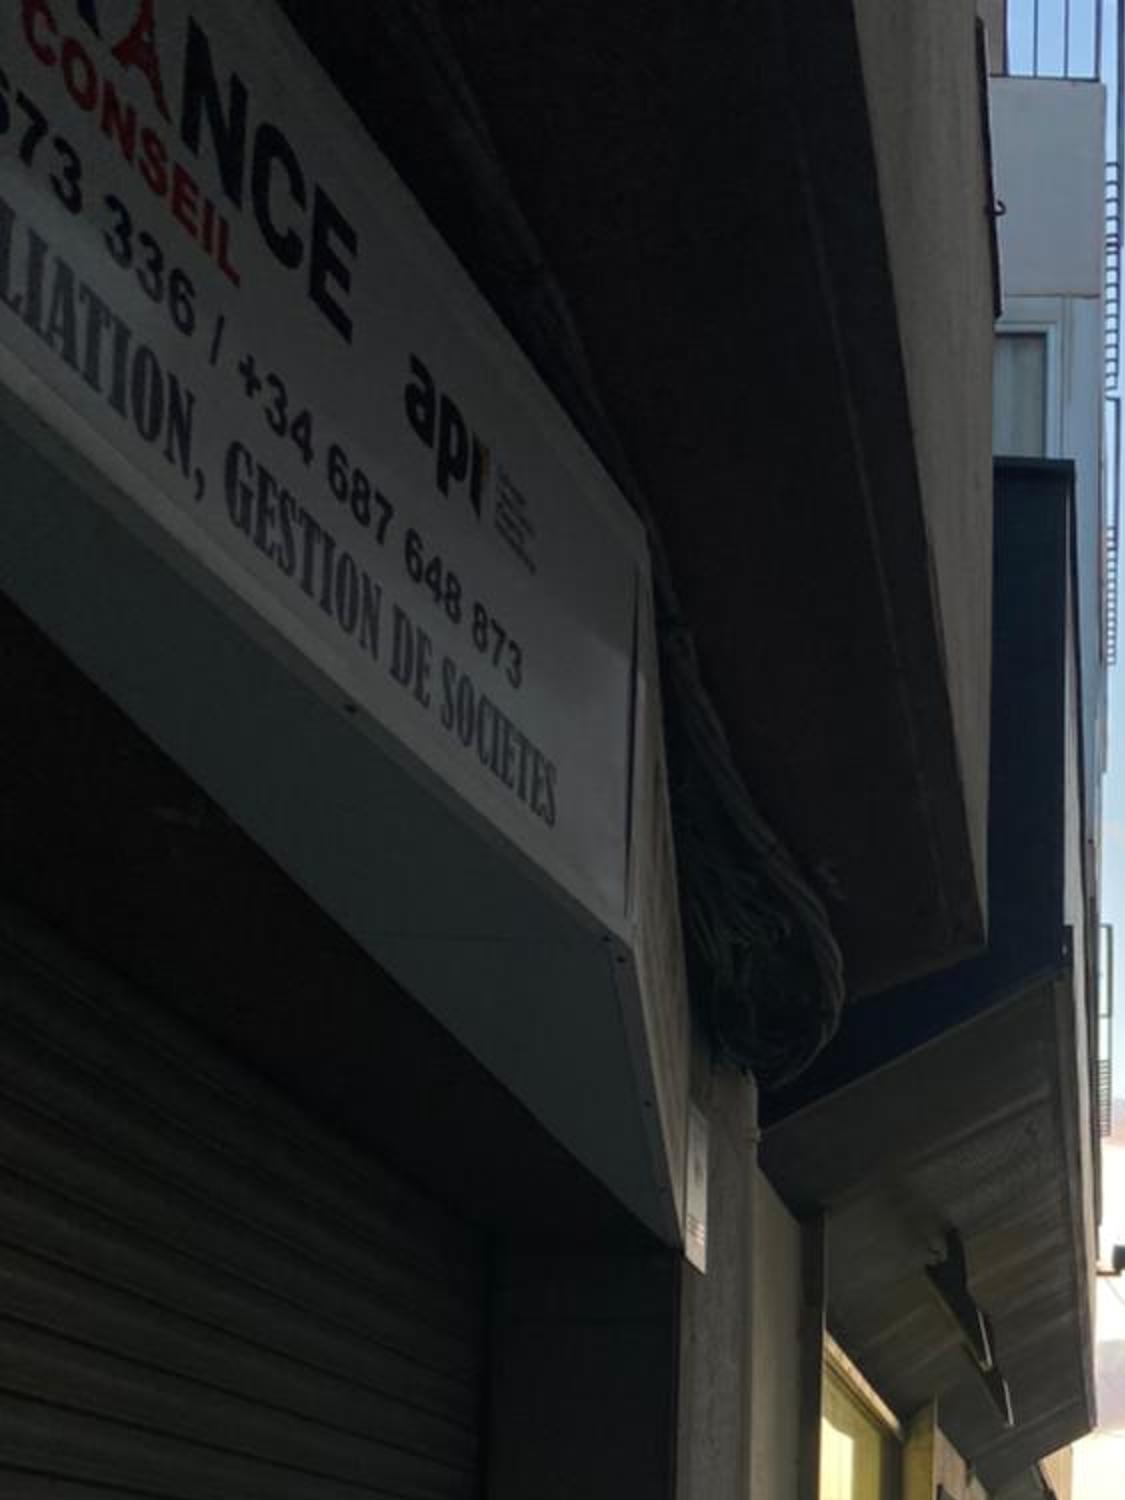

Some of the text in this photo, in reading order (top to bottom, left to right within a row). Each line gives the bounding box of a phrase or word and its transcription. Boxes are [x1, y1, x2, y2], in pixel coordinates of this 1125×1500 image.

[22, 0, 240, 288] CONSEIL
[78, 0, 358, 344] ANCE
[104, 193, 195, 337] 336
[209, 315, 225, 366] /
[238, 353, 314, 468] +34
[327, 442, 394, 546] 687
[404, 527, 462, 626] 648
[471, 603, 524, 690] 873
[223, 439, 381, 664] GESTION
[390, 604, 433, 709] DE
[440, 656, 557, 828] SOCIETES
